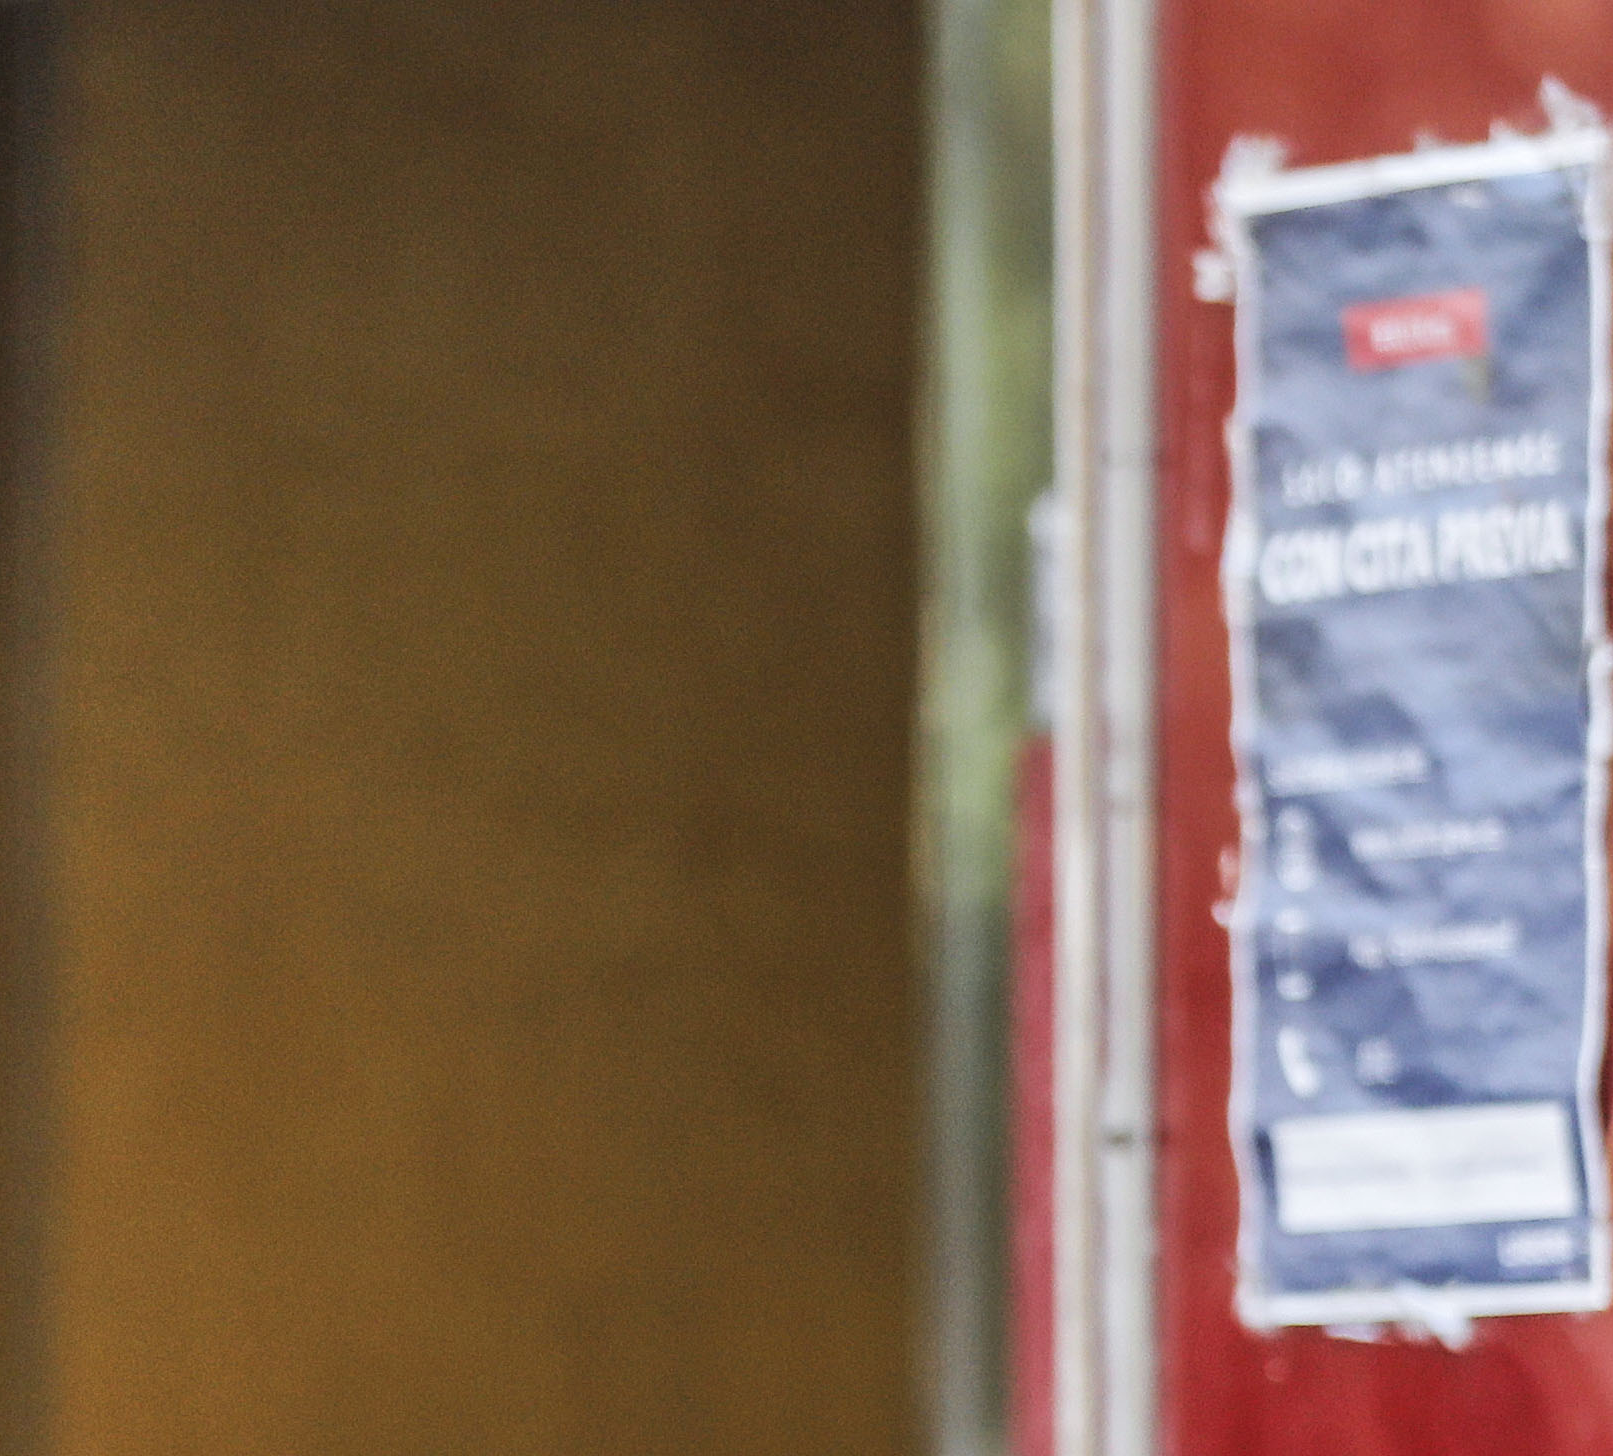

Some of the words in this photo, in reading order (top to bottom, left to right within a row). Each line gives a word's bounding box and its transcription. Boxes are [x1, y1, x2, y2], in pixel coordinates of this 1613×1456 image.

[1258, 530, 1342, 604] CON
[1343, 518, 1434, 594] CITA
[1435, 502, 1573, 582] PREVIA
